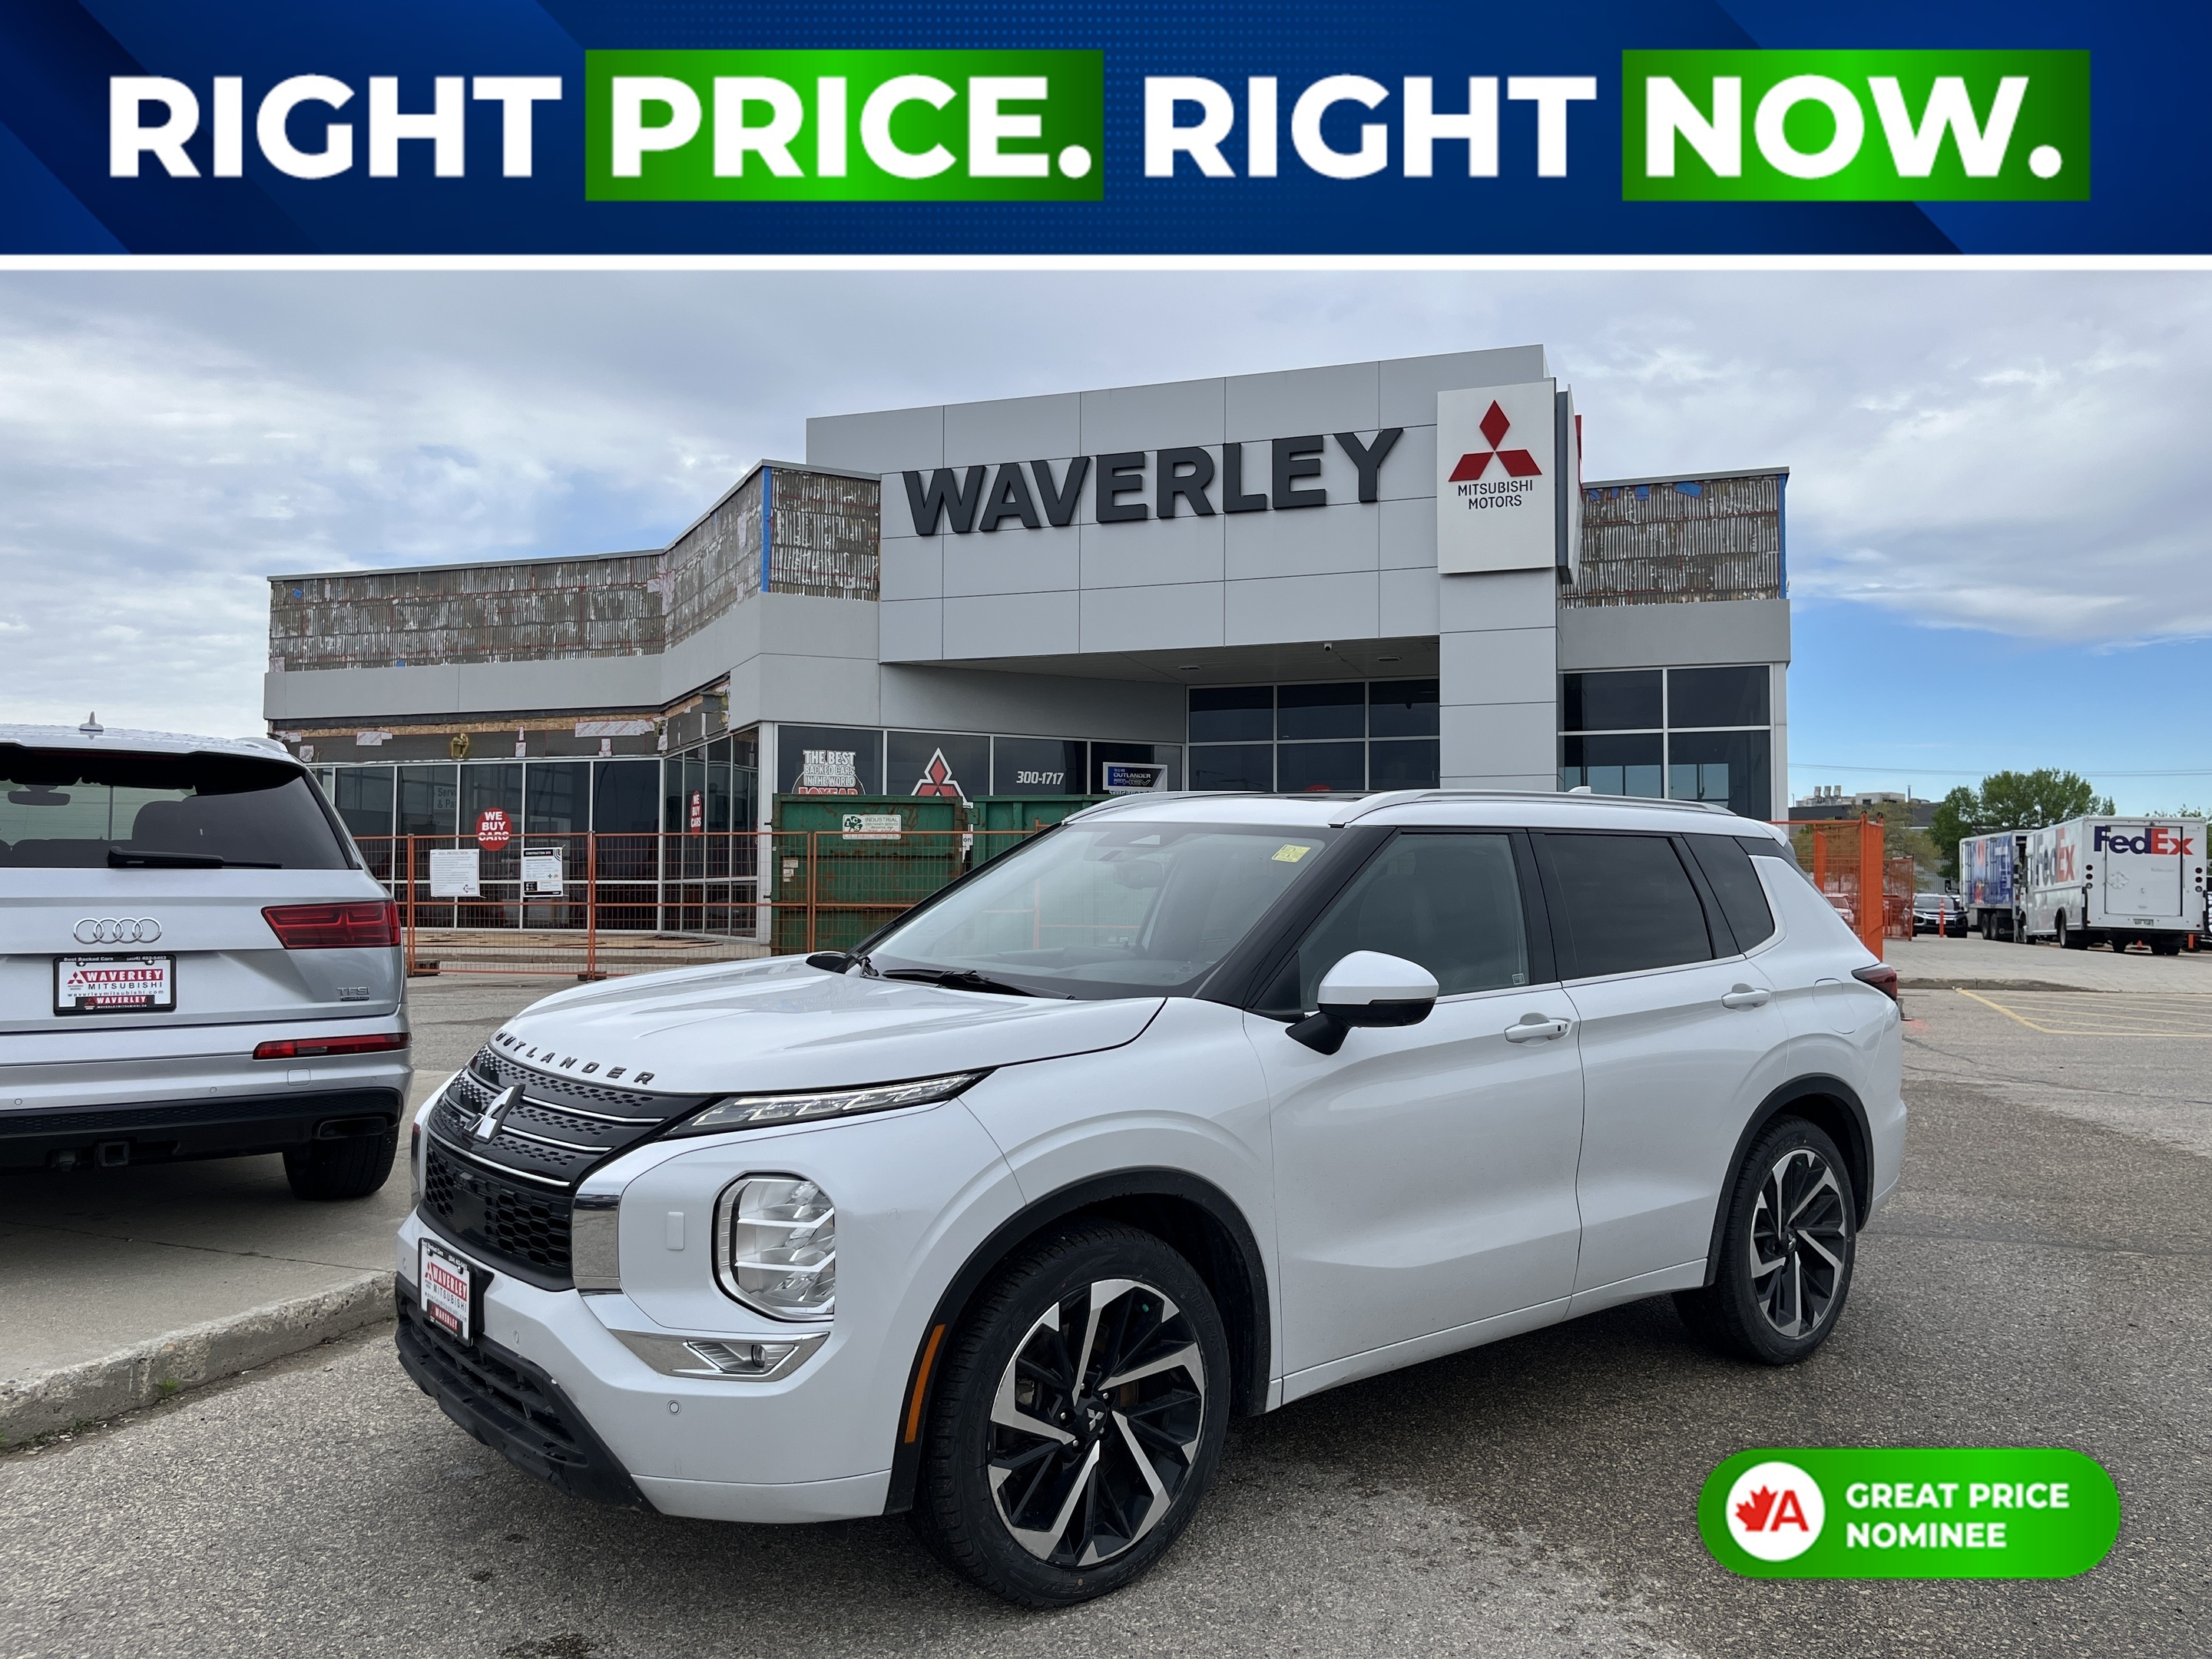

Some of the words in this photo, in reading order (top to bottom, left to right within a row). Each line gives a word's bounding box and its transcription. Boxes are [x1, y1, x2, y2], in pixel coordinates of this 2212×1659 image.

[902, 428, 1404, 536] WAVERLEY
[1458, 480, 1533, 497] MITSUBISHI
[1469, 495, 1522, 510] MOTORS
[803, 750, 826, 764] THE
[827, 750, 856, 766] BEST
[804, 765, 834, 775] BACKED
[835, 766, 856, 776] CARS
[829, 777, 855, 786] WORLD
[1016, 771, 1064, 784] 300-1717
[693, 794, 700, 805] WE
[485, 812, 502, 820] WE
[692, 806, 700, 816] BUY
[482, 822, 506, 831] BUY
[691, 816, 701, 827] CARS
[478, 831, 509, 841] CARS
[2094, 826, 2194, 856] FedEx
[87, 969, 162, 982] WAVERLEY
[88, 982, 163, 990] MITSUBISHI
[495, 1032, 655, 1084] OUTLANDER
[432, 1266, 467, 1300] WAVERLEY
[433, 1283, 467, 1313] MITSUBISHI
[435, 1306, 458, 1330] WAVERLEY
